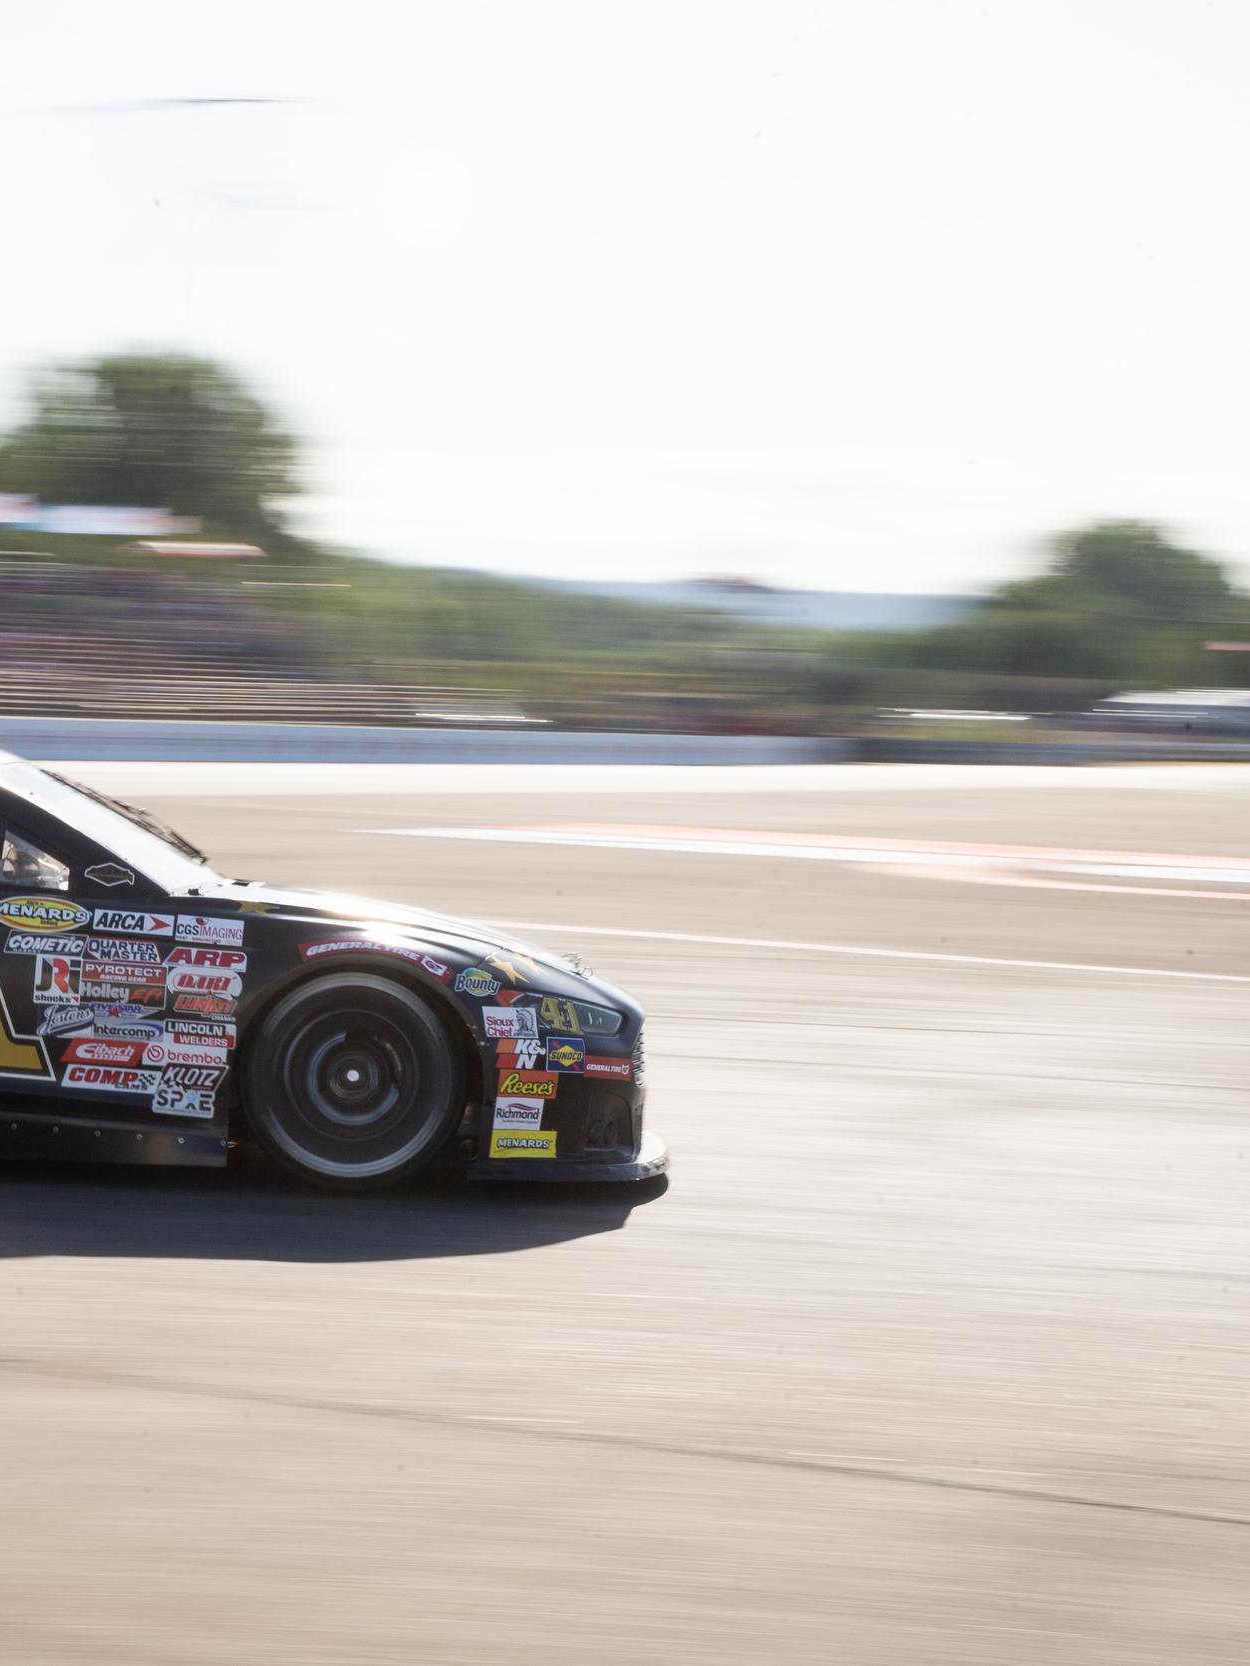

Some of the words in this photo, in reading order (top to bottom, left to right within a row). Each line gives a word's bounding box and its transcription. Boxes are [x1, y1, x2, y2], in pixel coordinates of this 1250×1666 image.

[95, 912, 145, 931] ARCA
[8, 934, 85, 954] COMETIC
[88, 940, 155, 953] QUARTER
[306, 941, 382, 956] GENERAL
[383, 944, 421, 961] TIRE
[100, 949, 159, 962] MASTER
[167, 948, 246, 968] ARP
[85, 963, 163, 978] PYROTECT
[454, 973, 501, 995] Bounty
[35, 993, 71, 1004] shocks
[81, 981, 130, 1004] Holley
[486, 1016, 514, 1027] Sioux
[540, 996, 585, 1035] 41
[93, 1023, 156, 1040] Intercomp
[167, 1022, 223, 1036] LINCOLN
[486, 1027, 513, 1037] Chief
[179, 1035, 228, 1047] WELDERS
[76, 1043, 136, 1061] Eibach
[167, 1049, 223, 1065] brembo
[550, 1051, 584, 1062] SUNOCO
[68, 1066, 139, 1085] COMP
[163, 1066, 221, 1086] KLOTZ
[586, 1064, 610, 1072] GENERAL
[610, 1065, 622, 1073] TIRE
[115, 1082, 149, 1091] CAMS
[499, 1072, 556, 1096] Reese's
[496, 1106, 540, 1120] Richmond
[497, 1138, 550, 1149] MENARDS
